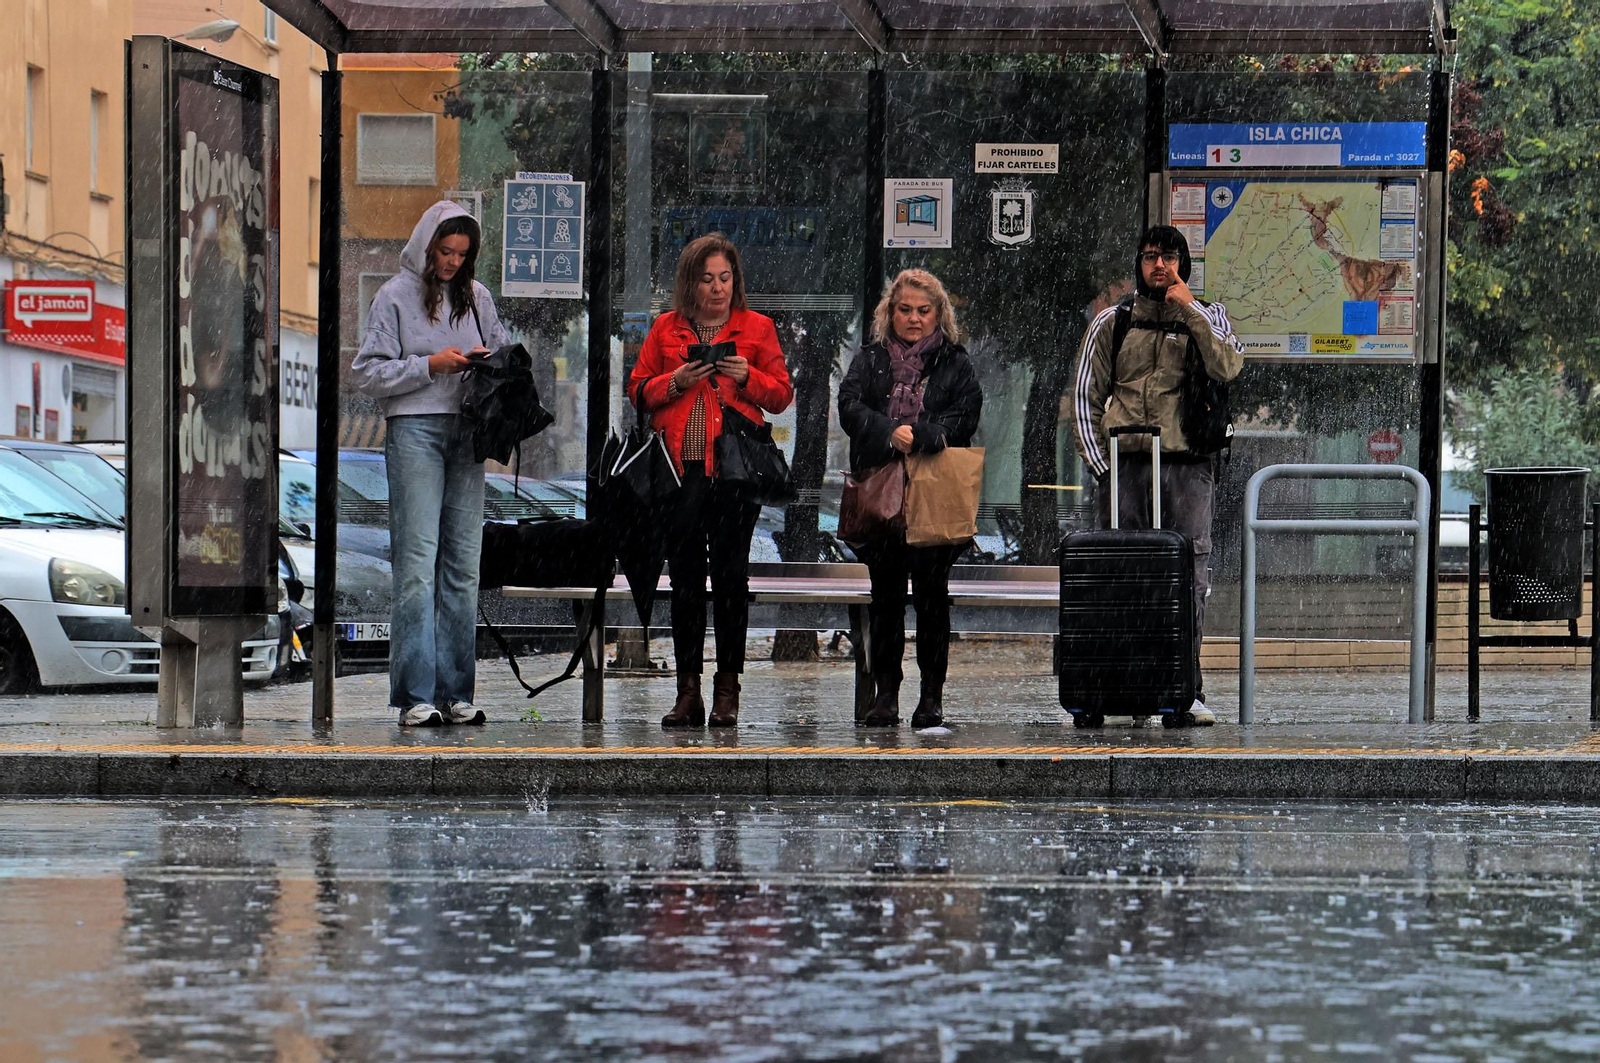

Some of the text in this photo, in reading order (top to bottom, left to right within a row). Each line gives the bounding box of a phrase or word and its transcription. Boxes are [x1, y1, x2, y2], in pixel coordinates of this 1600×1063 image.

[1249, 126, 1343, 141] ISLA CHICA
[991, 148, 1044, 157] PROHIBIDO
[1171, 148, 1242, 163] Líneas: 1 3
[1348, 153, 1382, 161] Parada
[1396, 153, 1420, 161] 3027
[977, 161, 1056, 169] FIJAR CARTELES
[519, 172, 570, 181] RECOMENDACIONES
[21, 294, 86, 312] el jamón
[1259, 341, 1281, 349] parada
[356, 624, 389, 639] H 764
